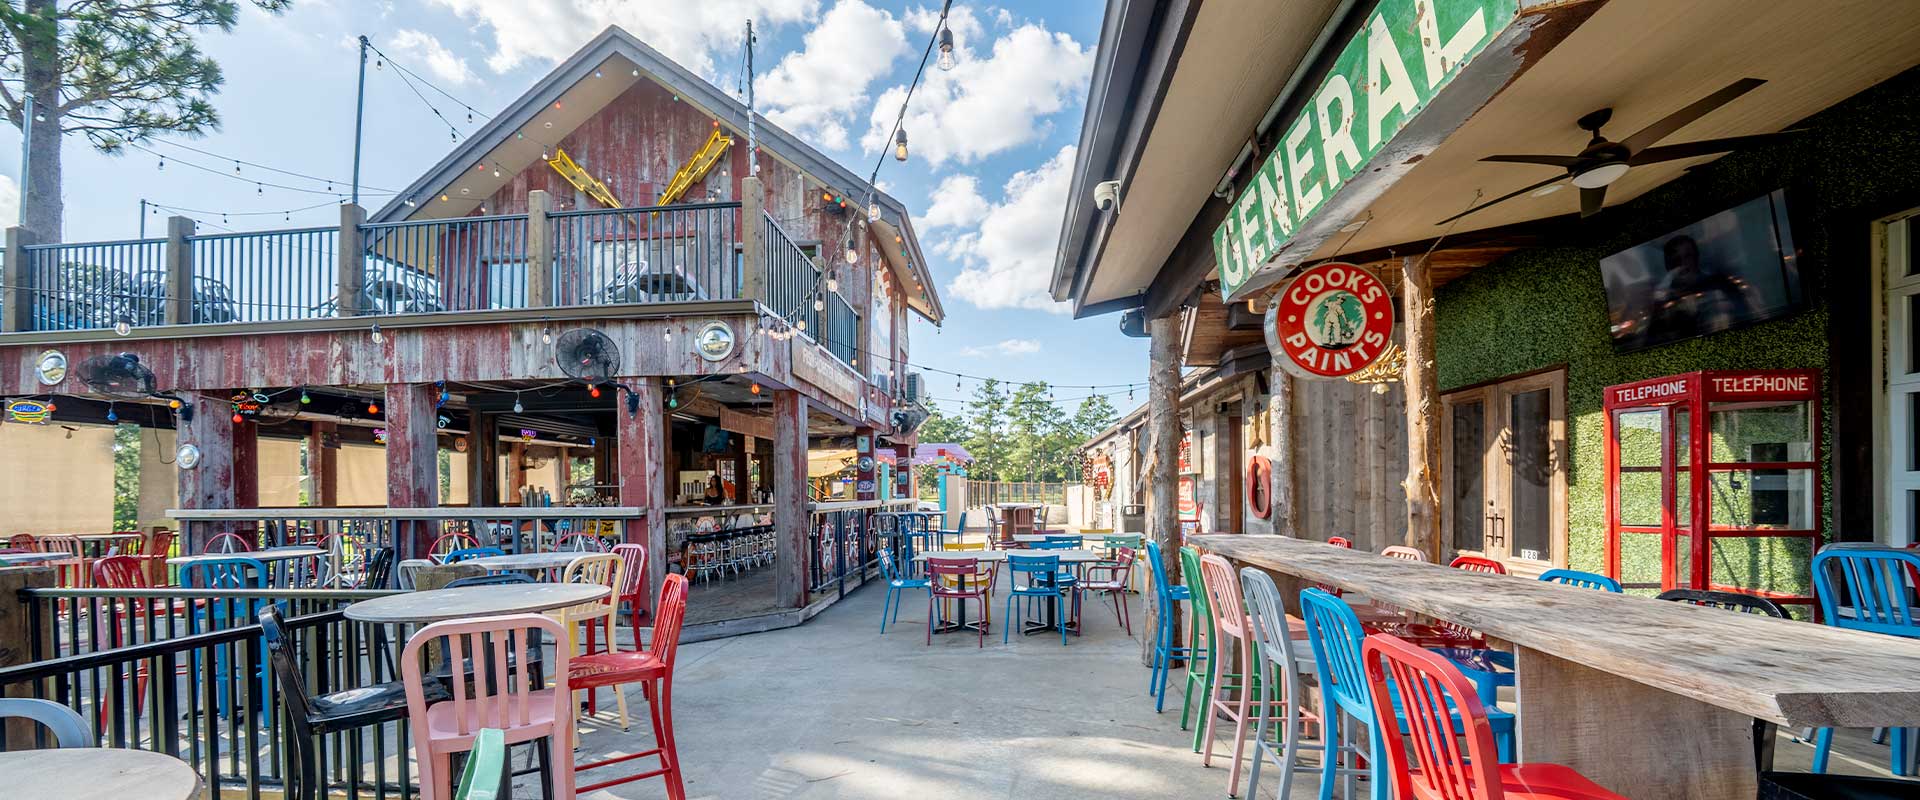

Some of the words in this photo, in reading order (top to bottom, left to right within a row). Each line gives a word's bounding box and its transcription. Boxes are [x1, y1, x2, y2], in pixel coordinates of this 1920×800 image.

[1221, 0, 1487, 287] GENERAL
[1290, 267, 1383, 306] COOK'S
[1286, 330, 1385, 372] PAINTS
[1616, 379, 1688, 402] TELEPHONE
[1711, 376, 1809, 393] TELEPHONE
[1522, 550, 1537, 560] 128
